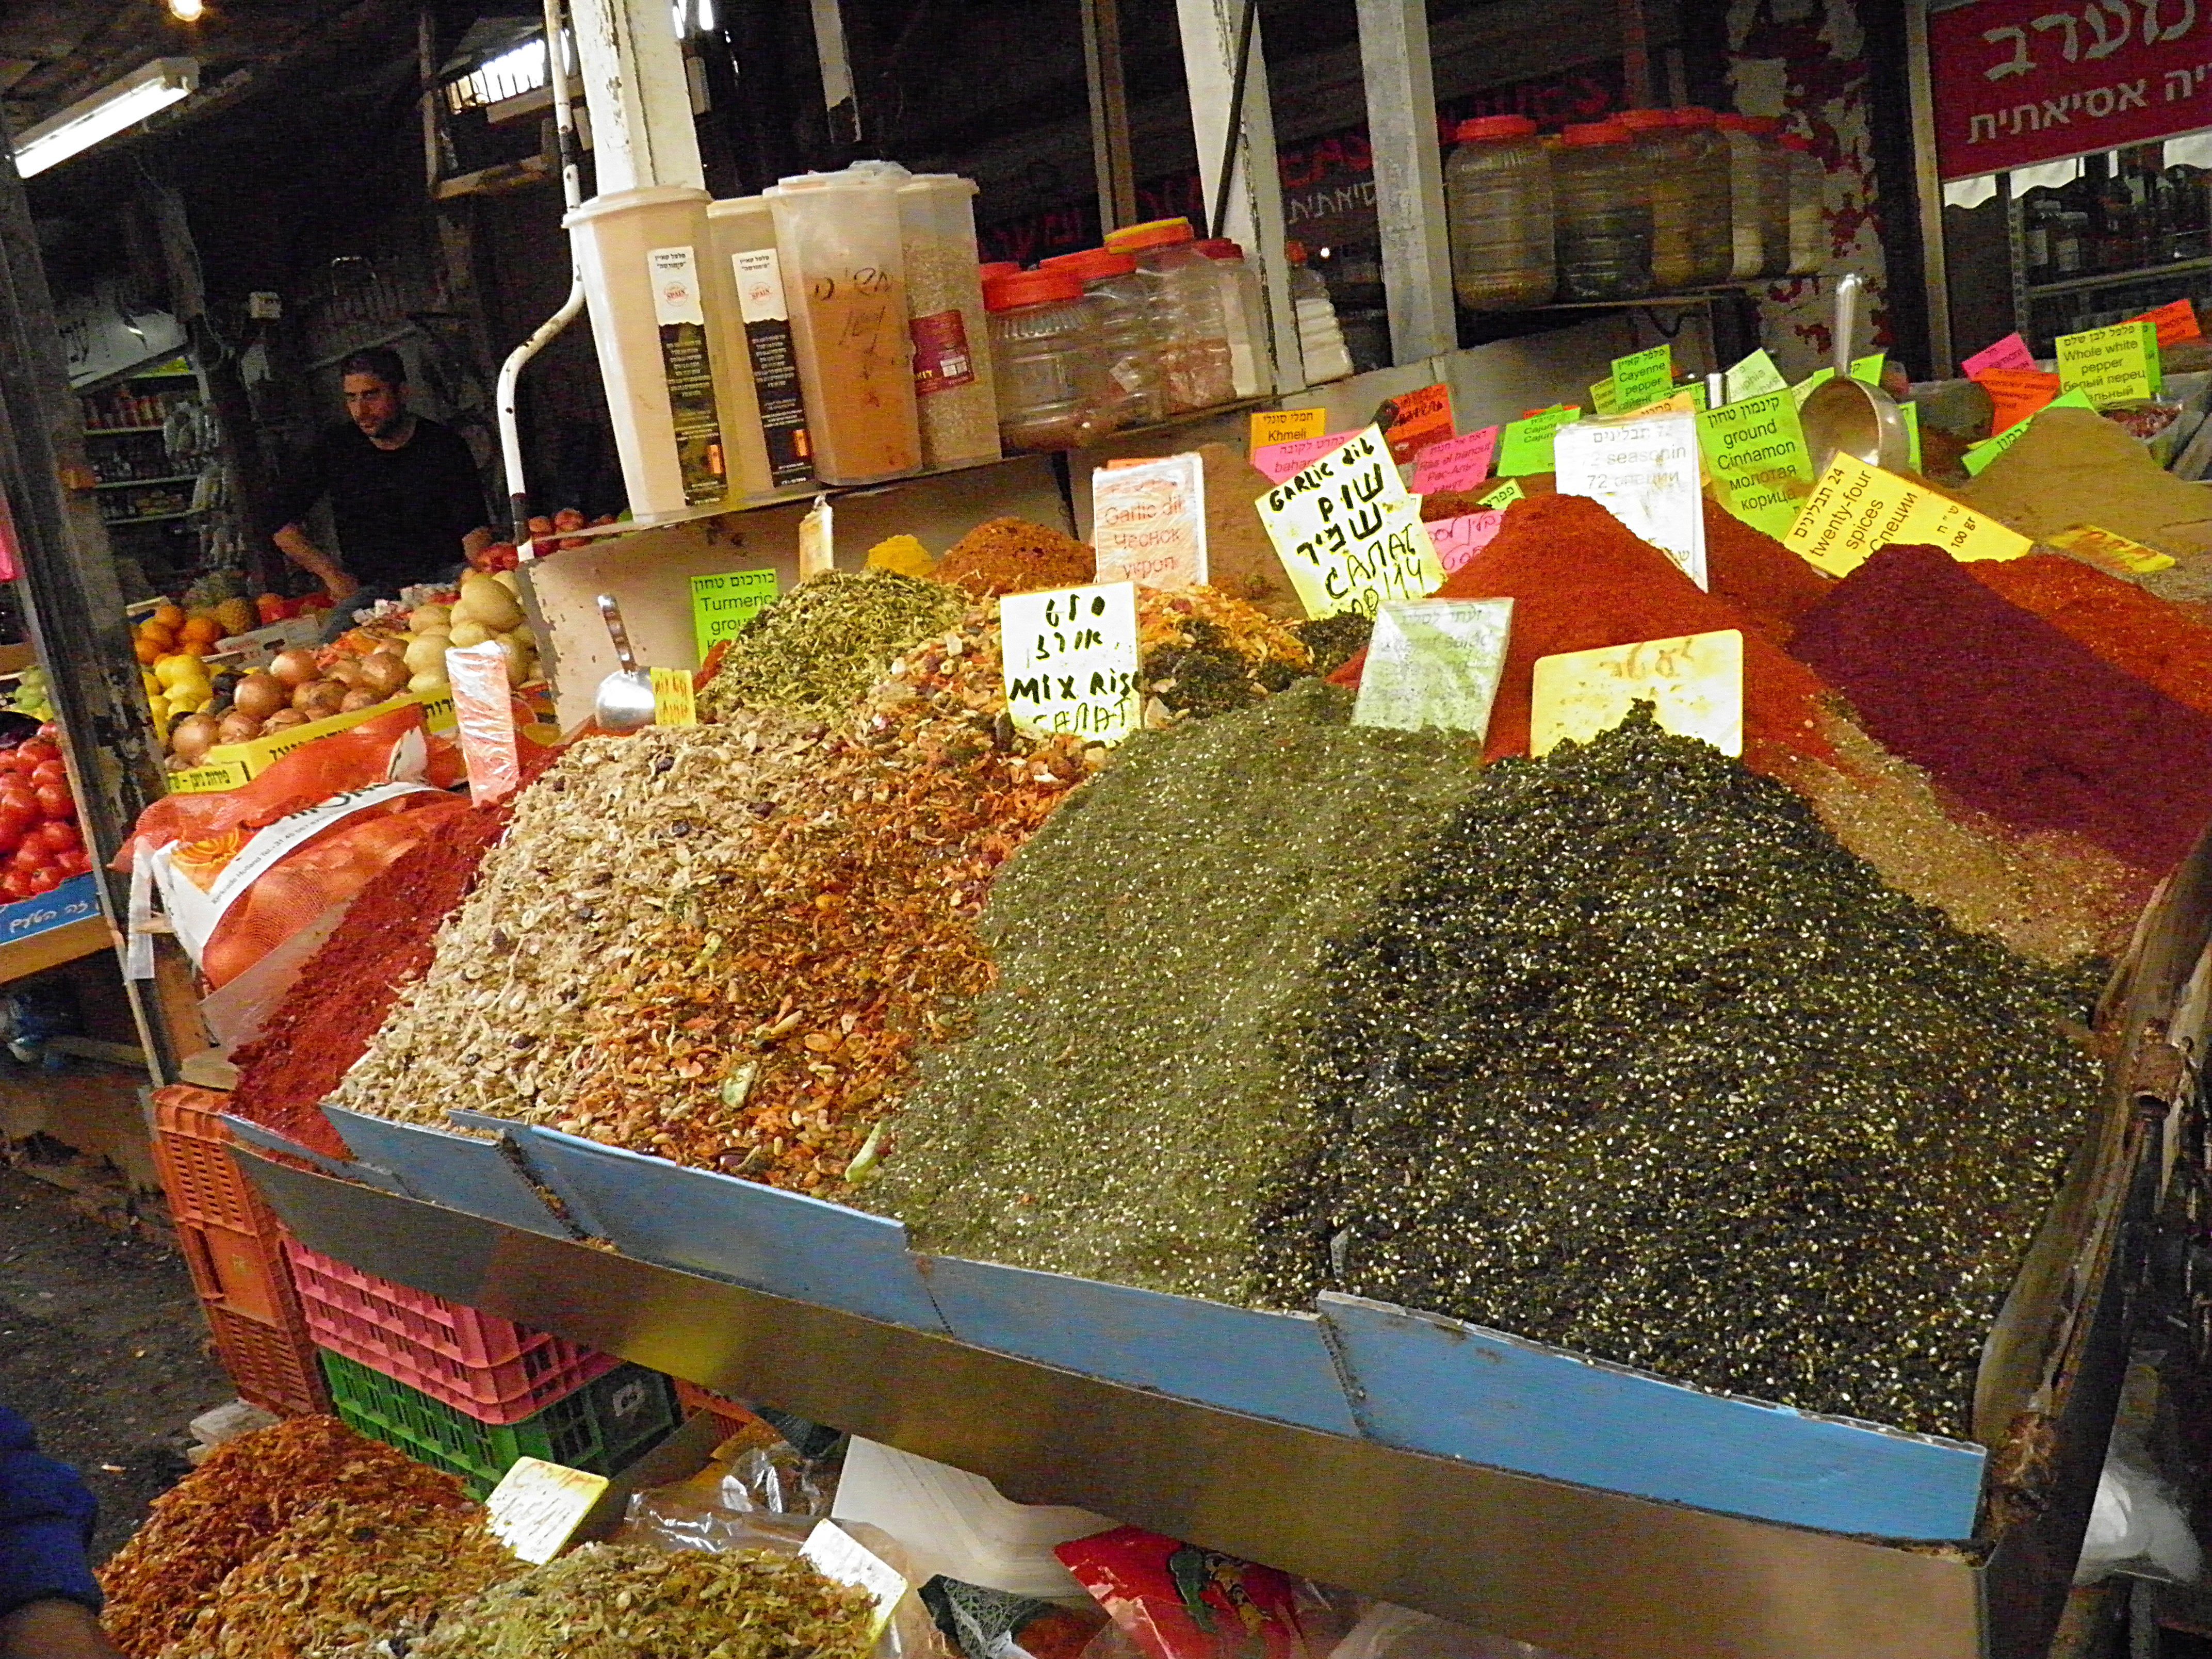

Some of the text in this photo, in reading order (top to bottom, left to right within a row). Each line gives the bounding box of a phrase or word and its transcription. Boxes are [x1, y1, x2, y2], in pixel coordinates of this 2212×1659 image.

[1967, 79, 2148, 144] אסיאתית
[2064, 326, 2135, 346] פלפל לבן שלם
[2063, 339, 2138, 361] Whole white
[1619, 362, 1666, 382] Cayenne
[2081, 357, 2123, 376] pepper
[2107, 369, 2146, 384] перец
[1625, 377, 1662, 397] pepper
[1707, 397, 1780, 428] קינמון טחון
[1268, 428, 1307, 442] Khmeli
[1593, 426, 1650, 443] תבלינים
[1723, 418, 1777, 449] ground
[1717, 441, 1796, 470] Cinnamon
[1587, 474, 1607, 489] 72
[1729, 465, 1797, 491] молотая
[1318, 463, 1384, 523] שום
[1486, 485, 1515, 507] פפרי
[1741, 489, 1795, 511] корица
[1793, 467, 1846, 539] 24 תבלינים
[1104, 502, 1157, 525] Garlic
[1810, 470, 1872, 557] twenty-four
[1845, 499, 1884, 550] spices
[1296, 502, 1383, 565] שמיר
[1950, 516, 1978, 548] 100 gr
[693, 577, 724, 593] טחון
[701, 592, 772, 611] Turmeric
[237, 856, 262, 879] Holland
